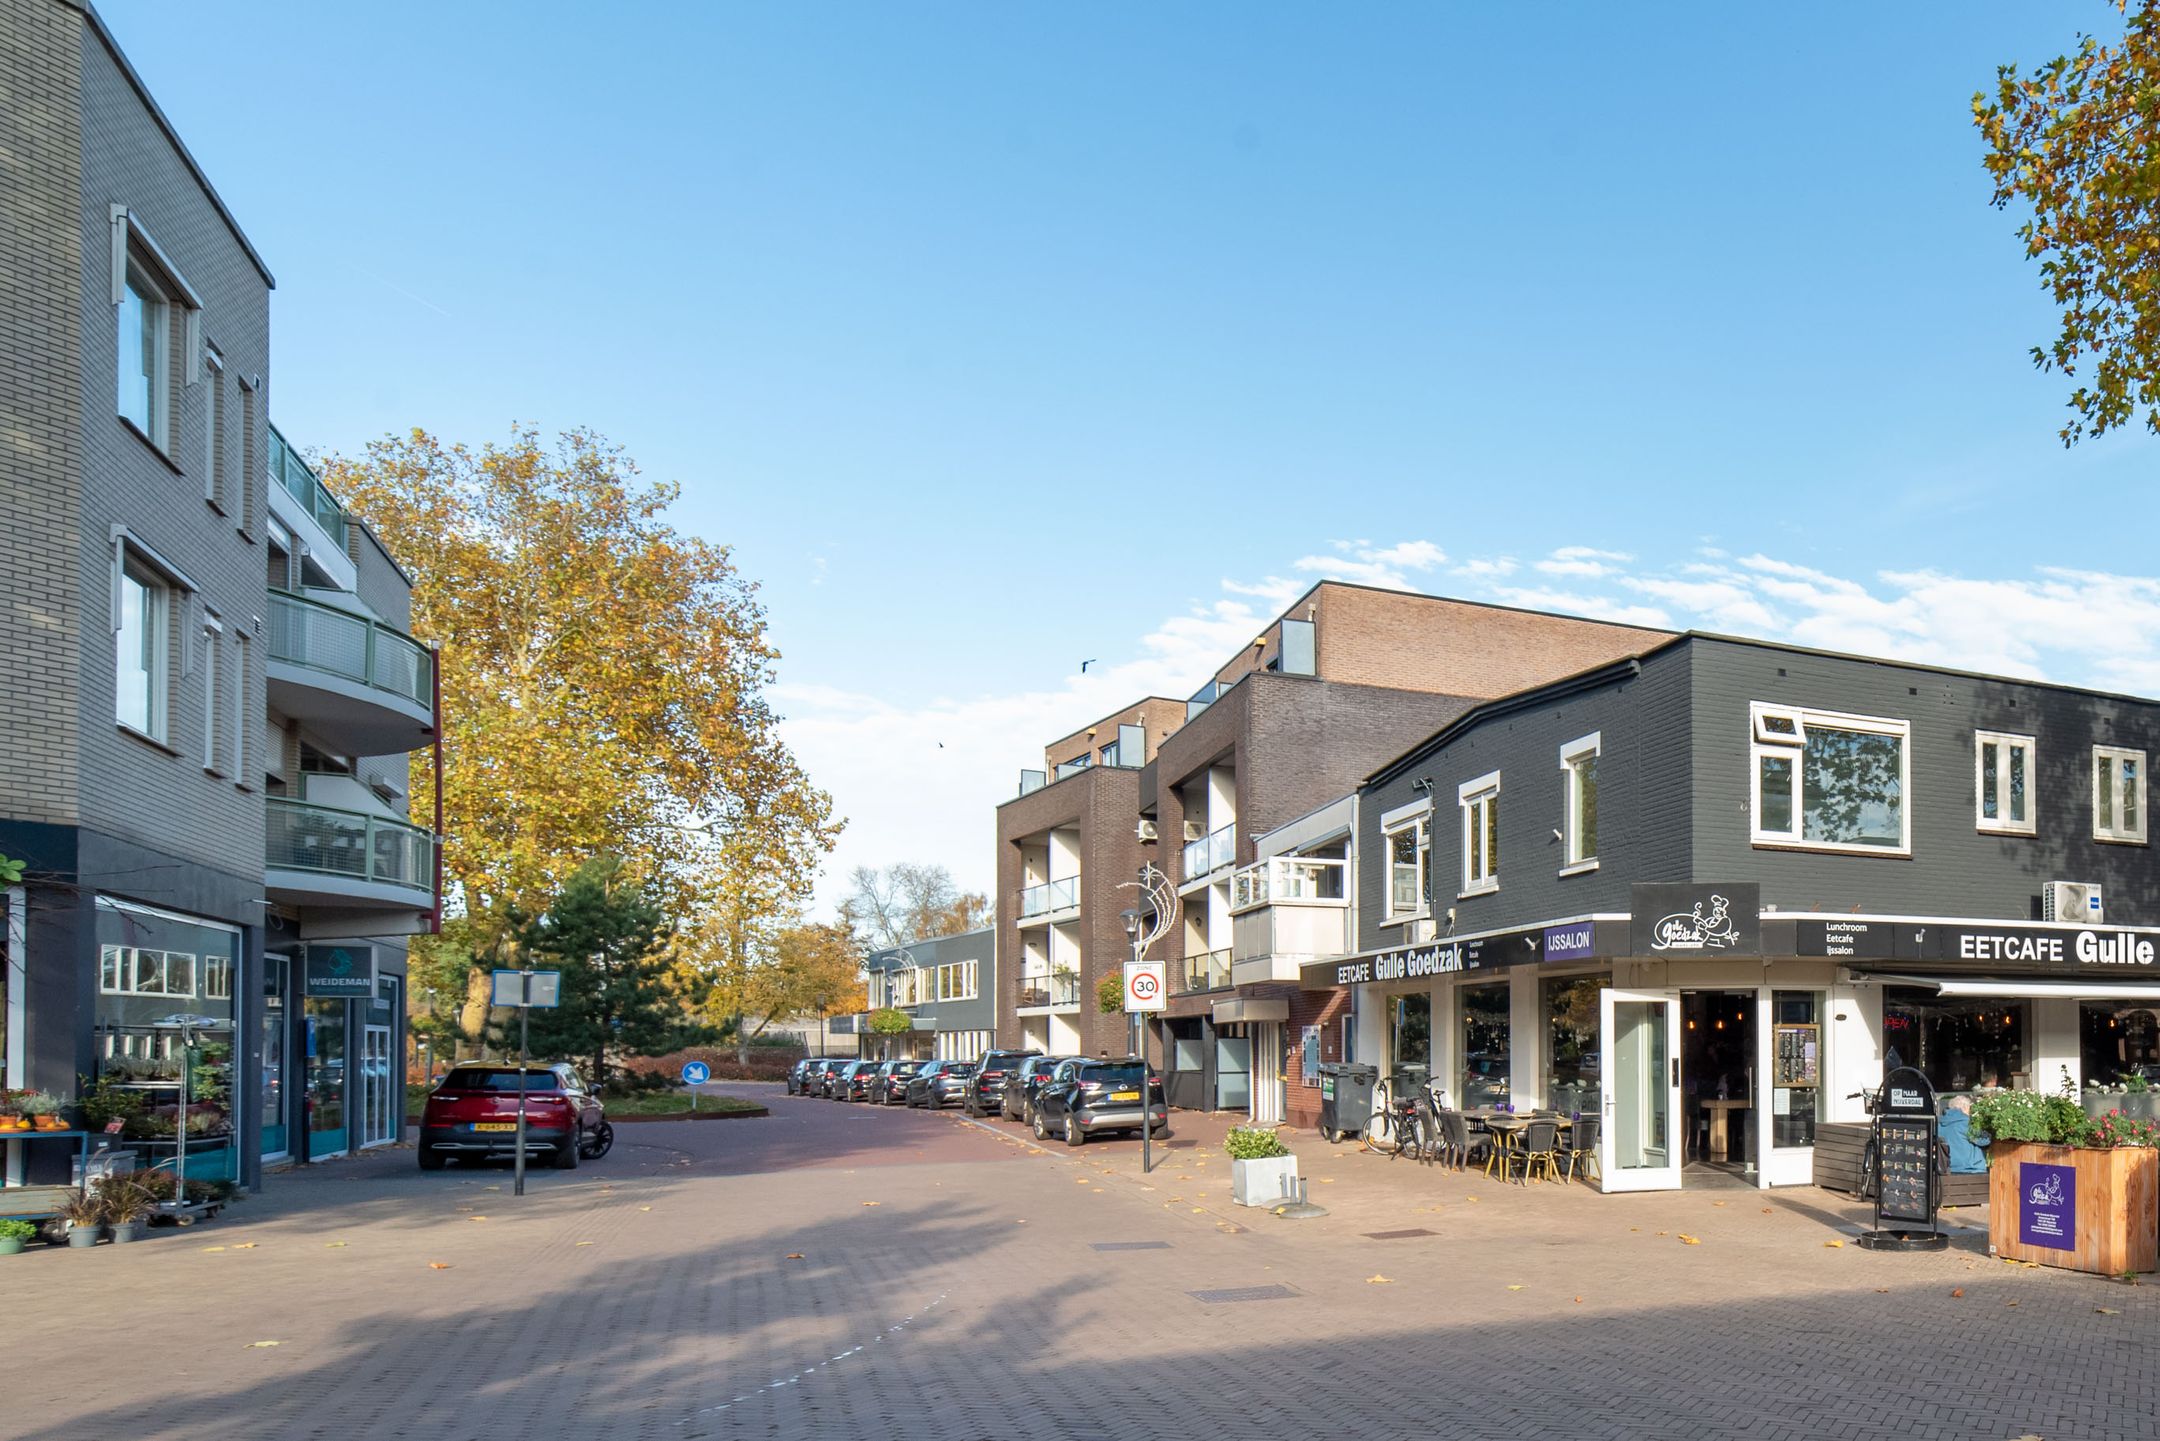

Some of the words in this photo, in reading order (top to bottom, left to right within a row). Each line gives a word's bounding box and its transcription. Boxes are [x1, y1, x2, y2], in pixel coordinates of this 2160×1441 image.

[1826, 922, 1868, 932] Lunchroom
[1548, 931, 1590, 951] IJSSALON
[1826, 933, 1854, 943] Eetcafe
[1960, 934, 2064, 962] EETCAFE
[2075, 930, 2155, 965] Gulle
[1338, 963, 1370, 984] EETCAFE
[1375, 952, 1405, 980] Gulle
[1407, 942, 1463, 977] Goedzak
[309, 978, 371, 986] WEIDEMAN
[1136, 981, 1155, 992] 30
